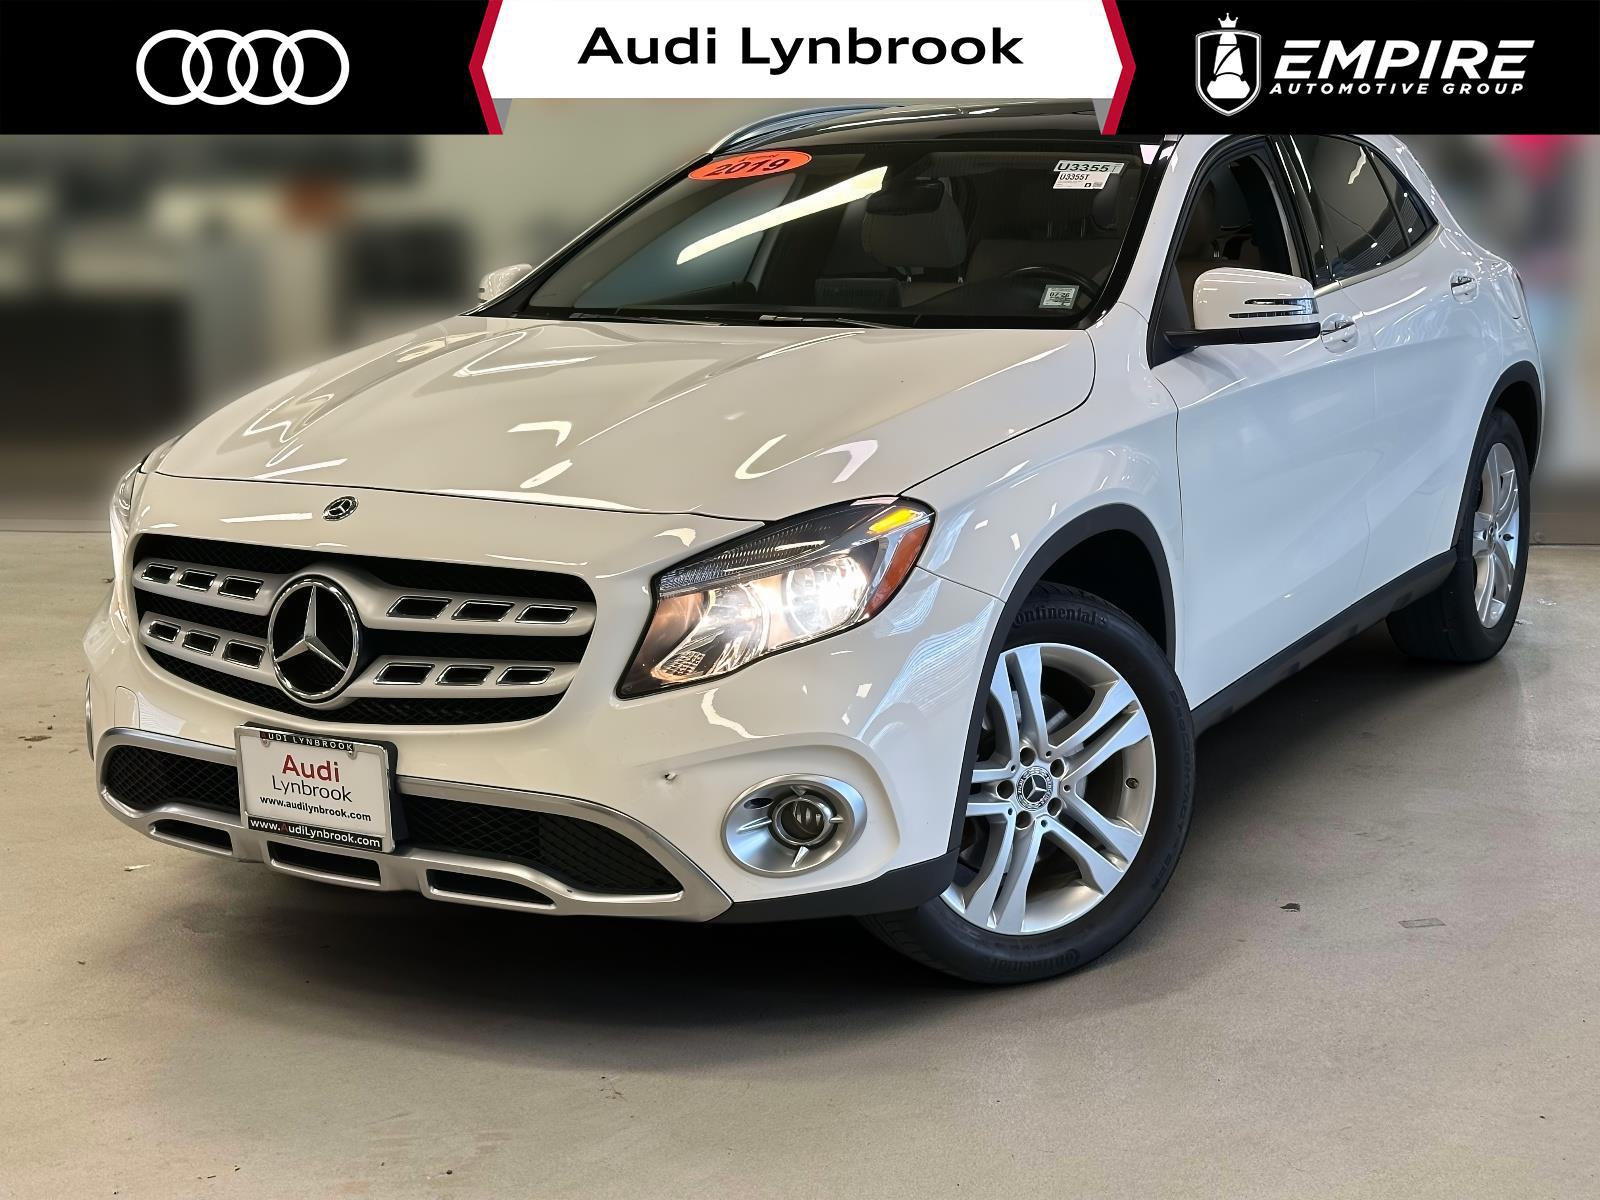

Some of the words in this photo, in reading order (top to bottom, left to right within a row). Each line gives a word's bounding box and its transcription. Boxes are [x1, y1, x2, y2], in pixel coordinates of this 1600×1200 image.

[703, 158, 791, 177] 2019
[260, 731, 288, 742] AUDI
[292, 735, 354, 751] LYNBROOK
[281, 754, 340, 783] Audi
[271, 774, 353, 803] Lynbrook
[259, 796, 372, 822] www.audilynbrook.com
[249, 819, 381, 848] www.AudiLynbrook.com
